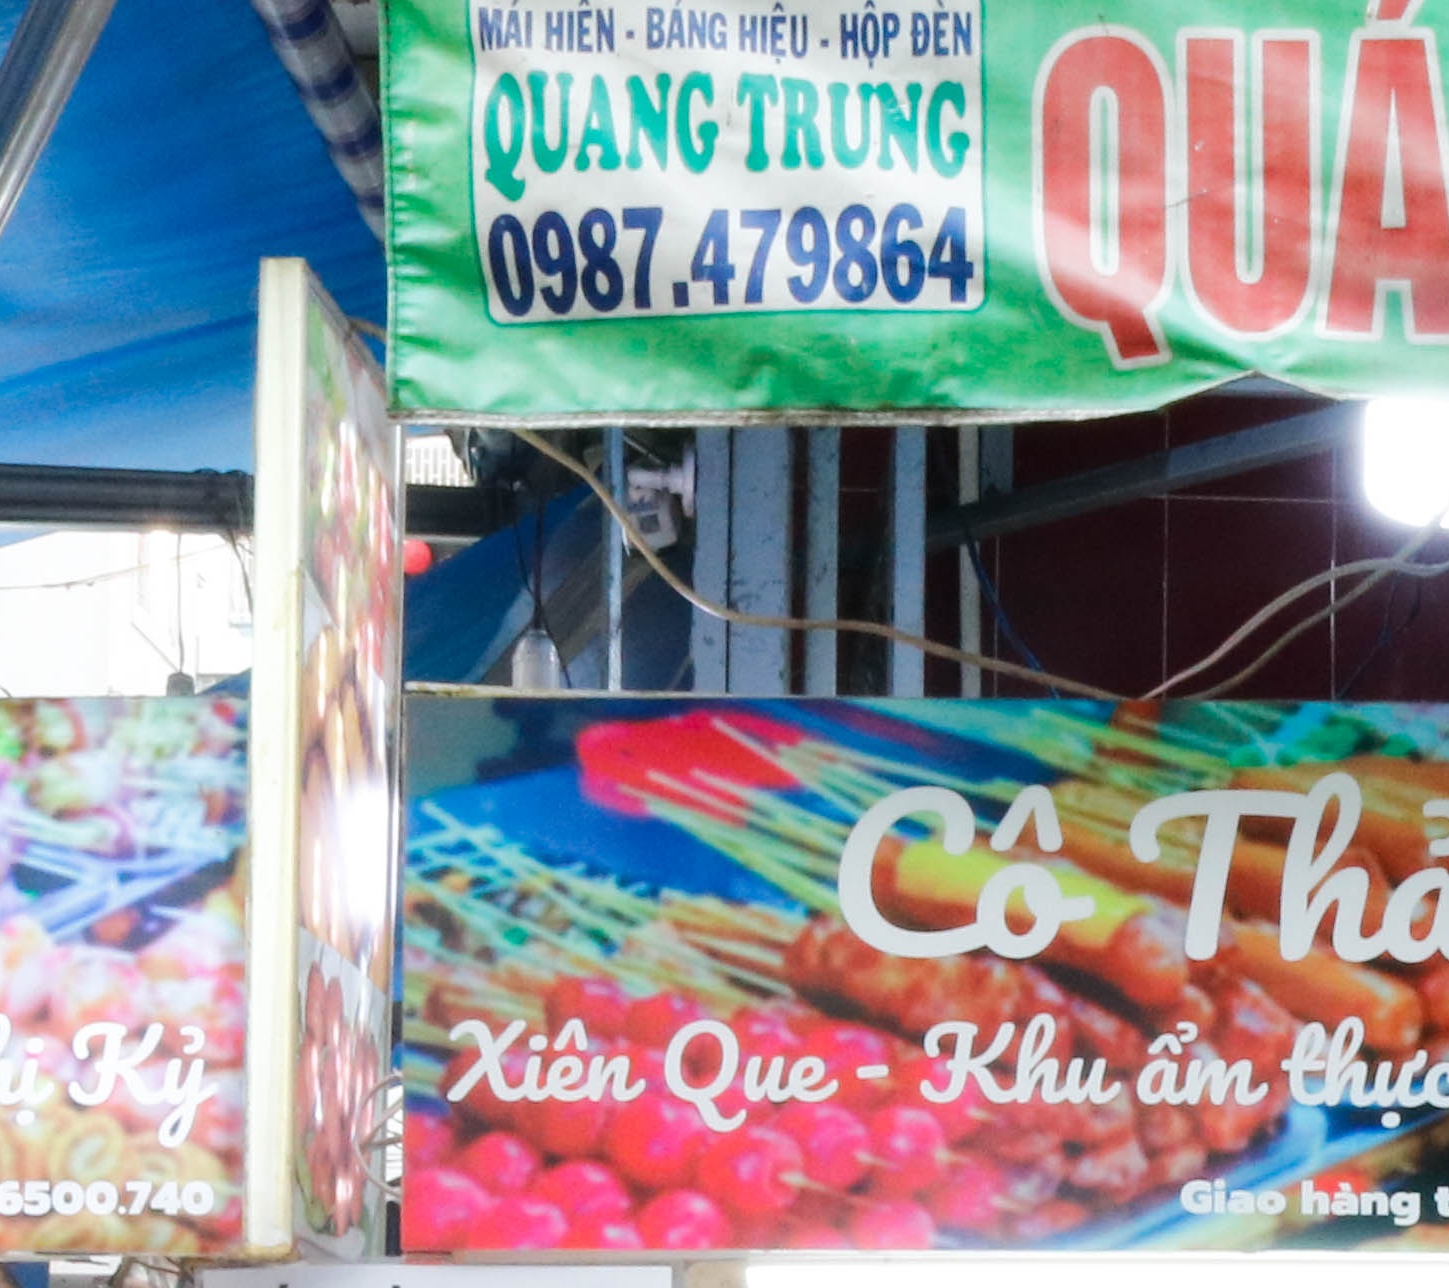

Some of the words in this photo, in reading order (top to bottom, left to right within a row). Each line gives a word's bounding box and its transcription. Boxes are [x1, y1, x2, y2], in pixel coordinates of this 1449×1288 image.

[484, 70, 719, 202] QUANG
[736, 73, 971, 178] TRUNG
[488, 203, 974, 316] 0987.479864
[838, 785, 1095, 960] Cô
[72, 1022, 217, 1147] Kỷ
[447, 1017, 645, 1105] Xiên
[664, 1019, 840, 1133] Que
[919, 1011, 1123, 1105] Khu
[1137, 1020, 1268, 1108] ẩm
[1180, 1178, 1287, 1217] Giao
[1301, 1178, 1421, 1228] hàng
